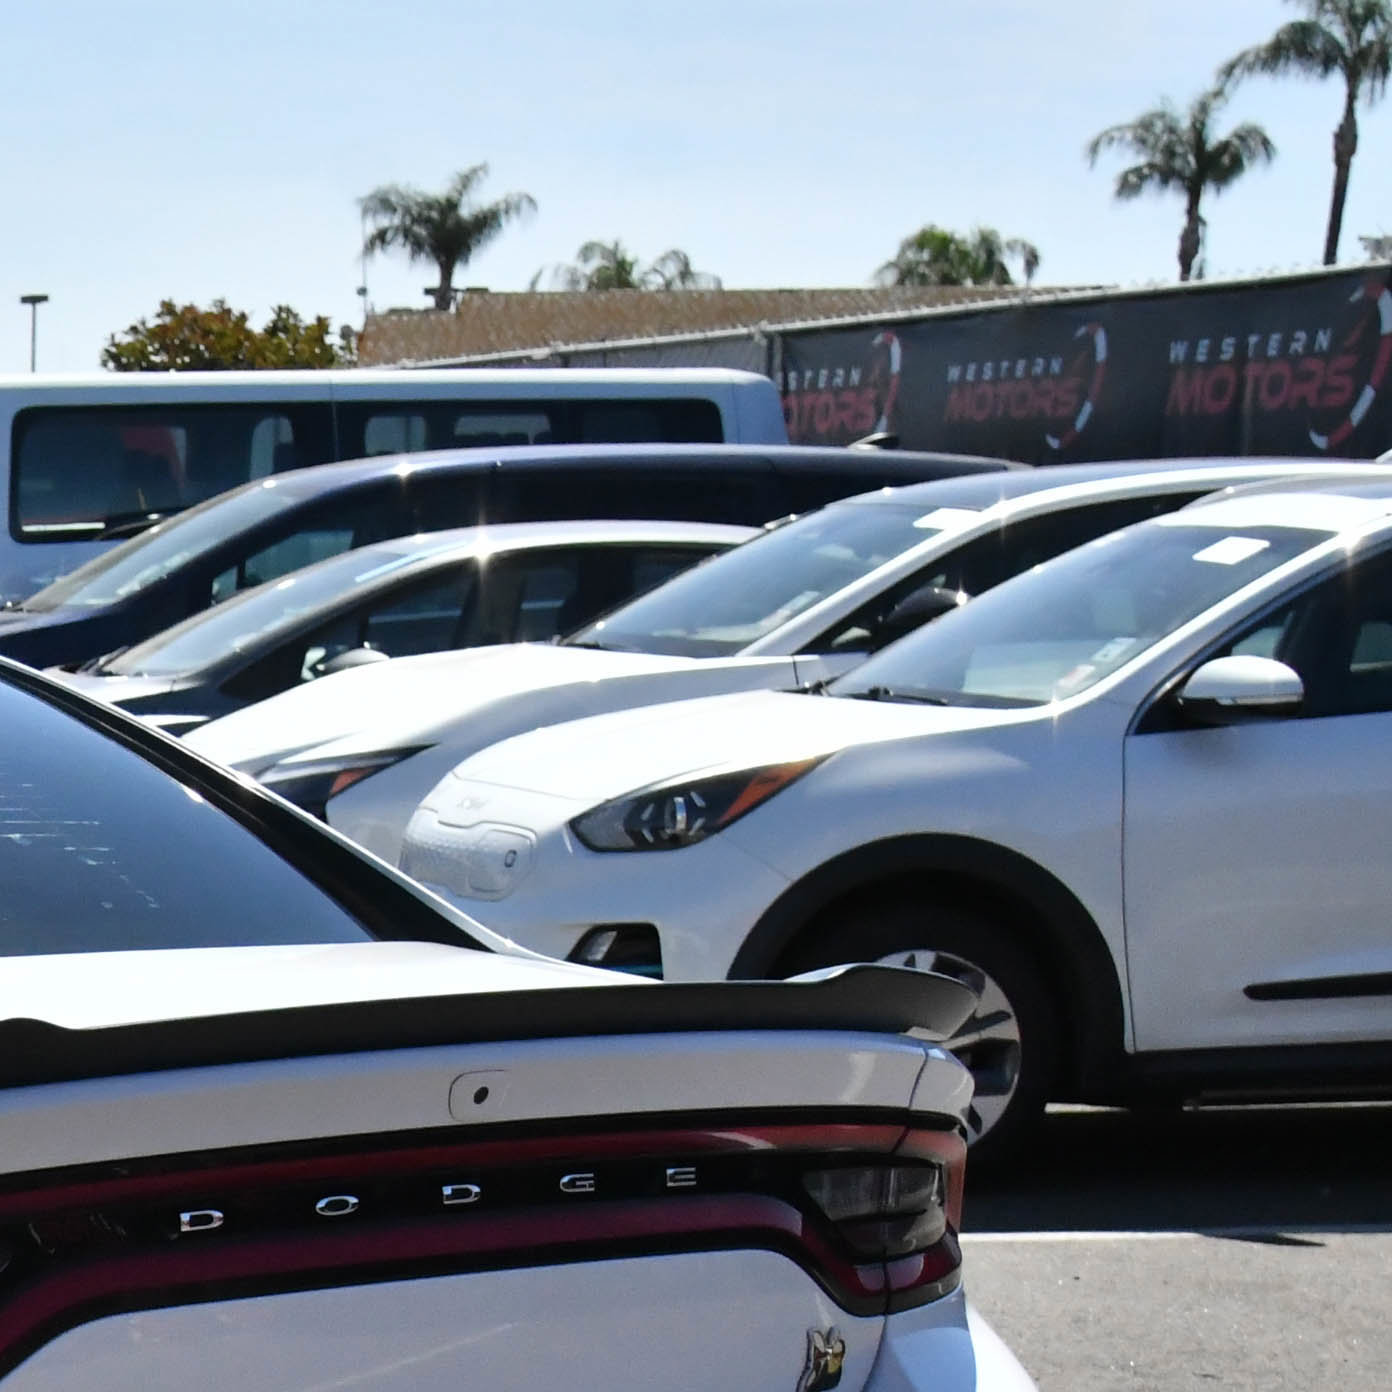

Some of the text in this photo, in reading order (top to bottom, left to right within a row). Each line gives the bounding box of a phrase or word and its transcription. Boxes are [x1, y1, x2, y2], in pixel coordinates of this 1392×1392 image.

[1169, 327, 1332, 364] WESTERN
[947, 357, 1063, 383] WESTERN
[1166, 354, 1359, 417] MOTORS
[781, 387, 878, 434] OTORS
[180, 1167, 697, 1232] DODGE
